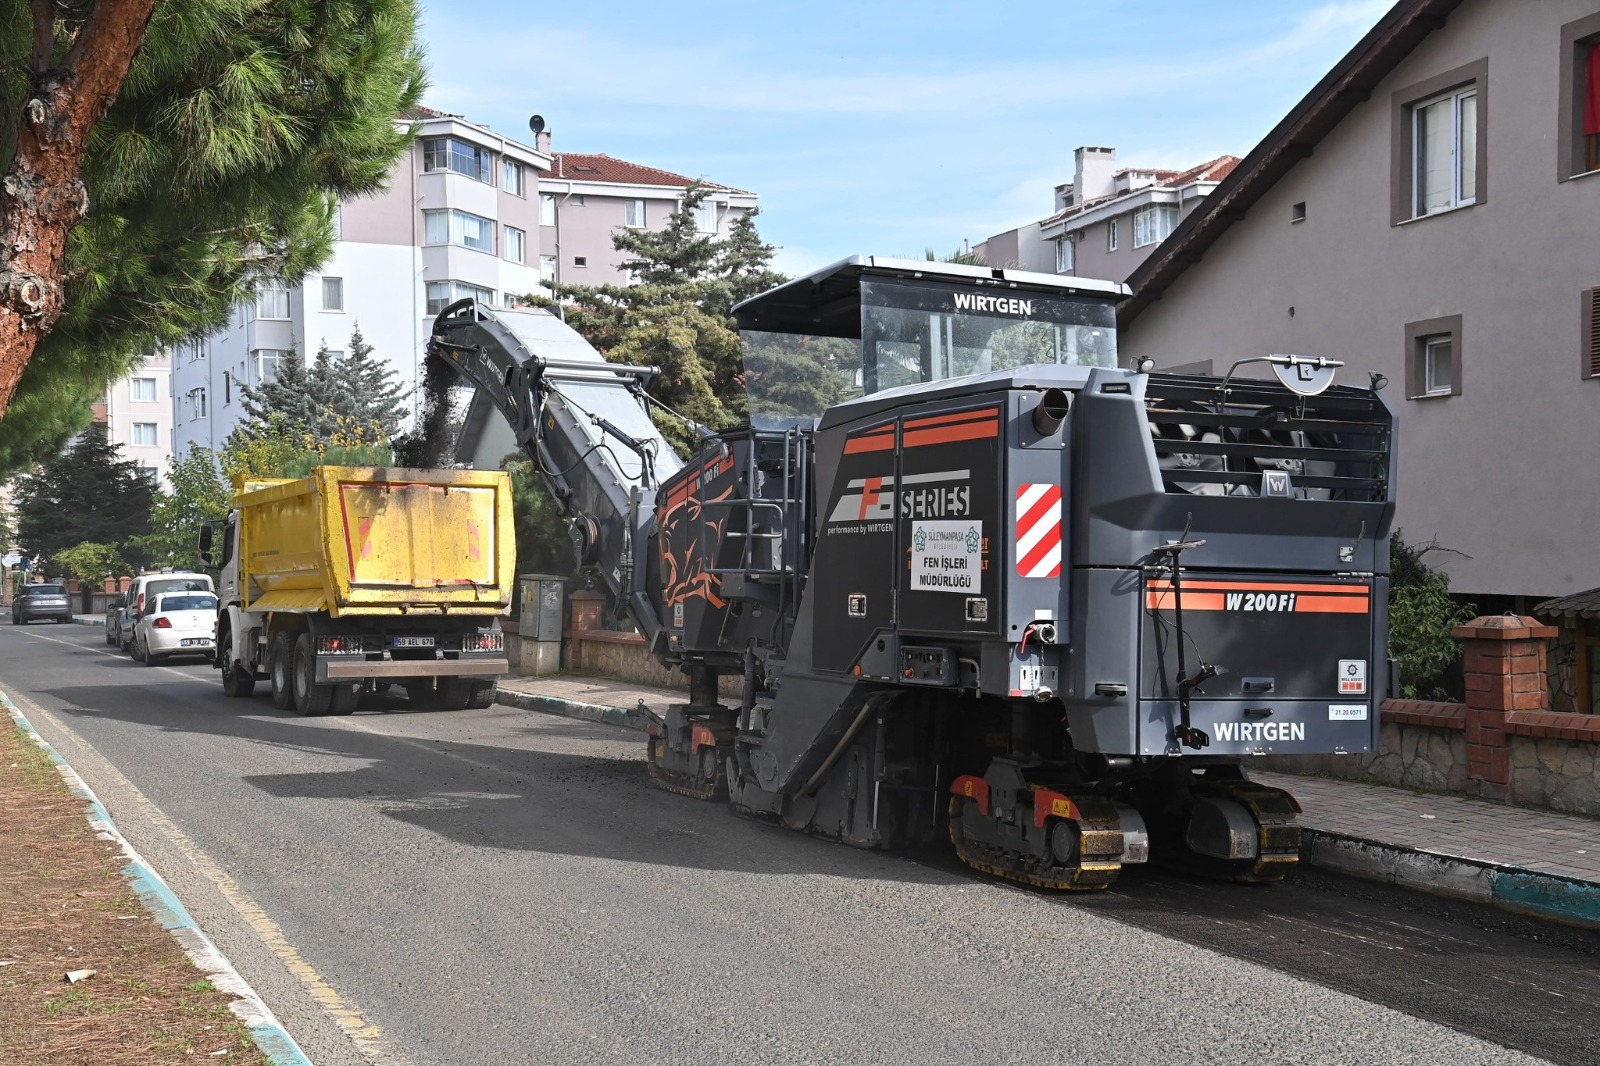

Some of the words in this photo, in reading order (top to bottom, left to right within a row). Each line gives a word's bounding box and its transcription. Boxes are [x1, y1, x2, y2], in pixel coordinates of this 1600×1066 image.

[953, 292, 1032, 316] WIRTGEN
[827, 524, 860, 537] performance
[859, 523, 867, 536] by
[867, 523, 894, 533] WIRTGEN
[923, 557, 939, 568] FEN
[941, 555, 968, 571] İŞLERİ
[919, 572, 971, 588] MÜDÜRLÜĞÜ
[1213, 722, 1305, 741] WIRTGEN
